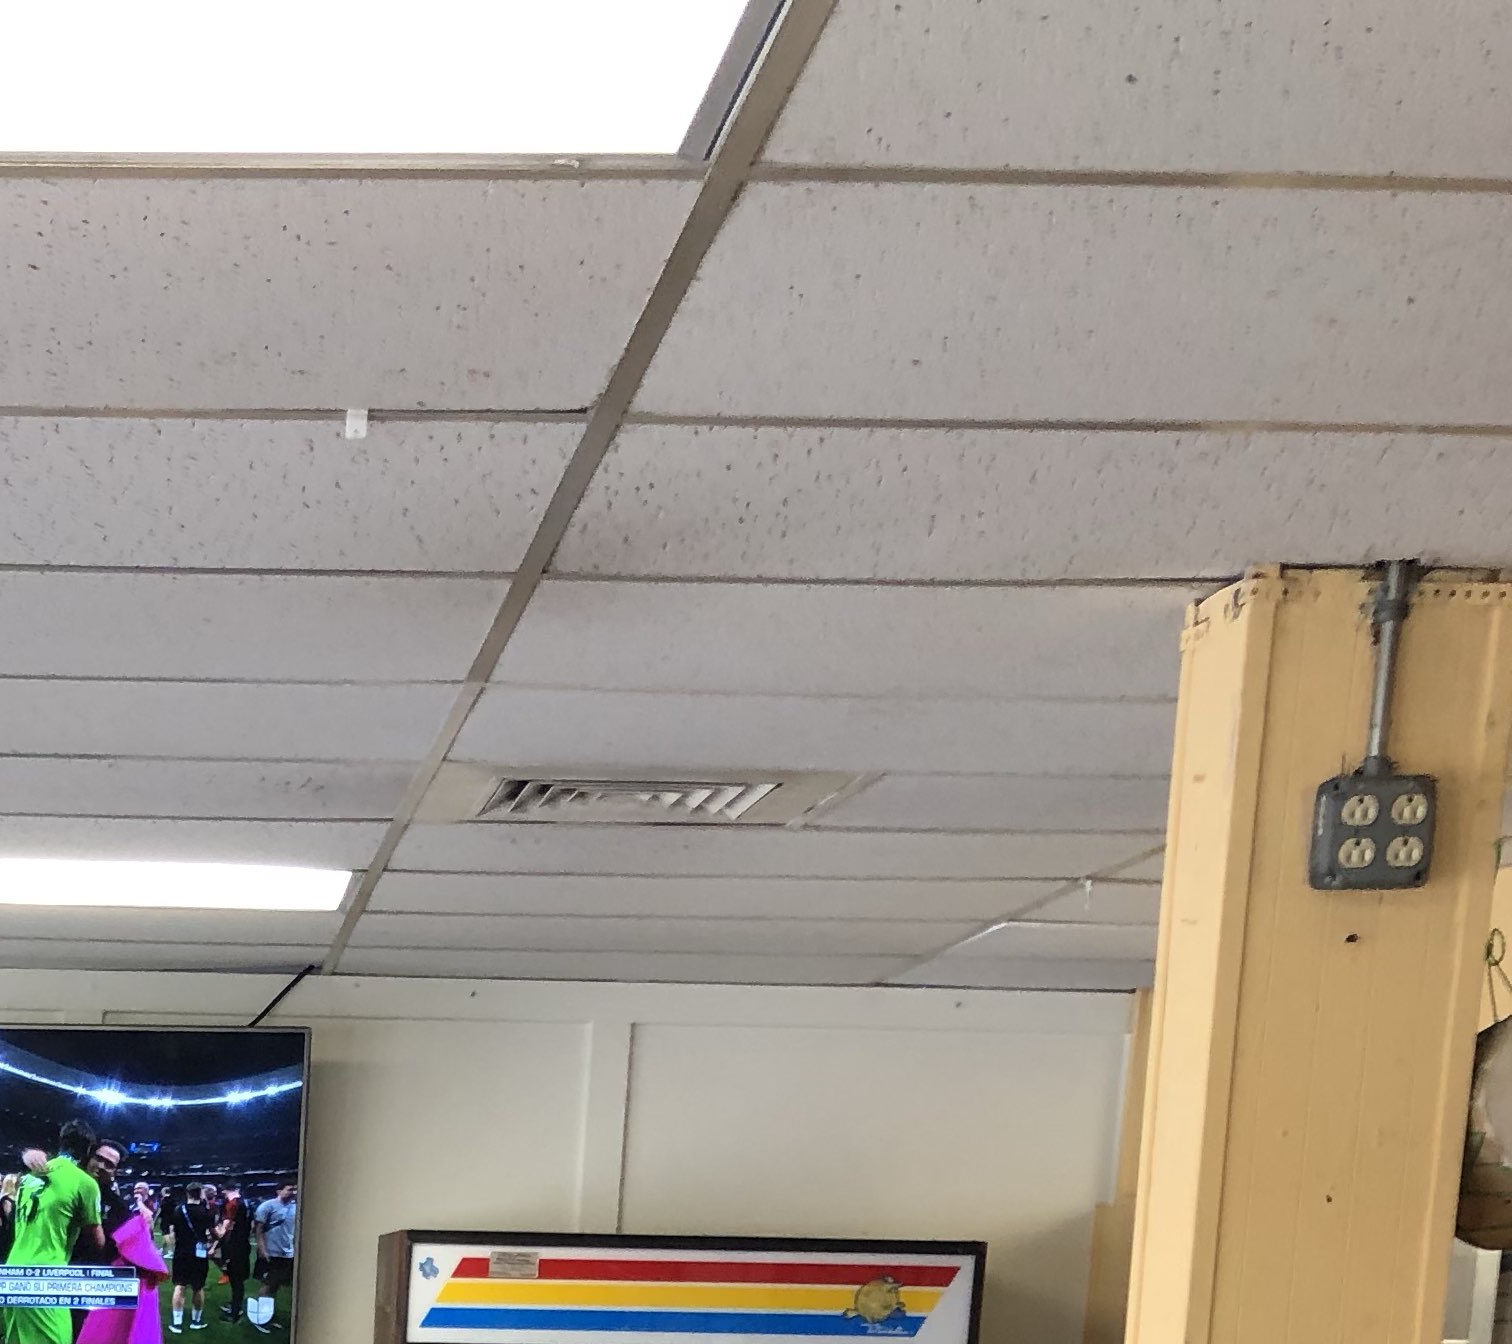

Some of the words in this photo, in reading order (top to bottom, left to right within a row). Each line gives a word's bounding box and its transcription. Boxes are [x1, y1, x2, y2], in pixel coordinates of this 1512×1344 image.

[42, 1268, 85, 1278] LIVERPOOL
[91, 1268, 114, 1278] FINAL
[34, 1282, 44, 1292] SU
[47, 1282, 83, 1293] PRIMERA
[85, 1283, 133, 1293] CHAMPIONS
[7, 1295, 57, 1305] DERROTADO
[59, 1296, 71, 1305] EN
[73, 1296, 79, 1305] 2
[81, 1296, 116, 1306] FINALES
